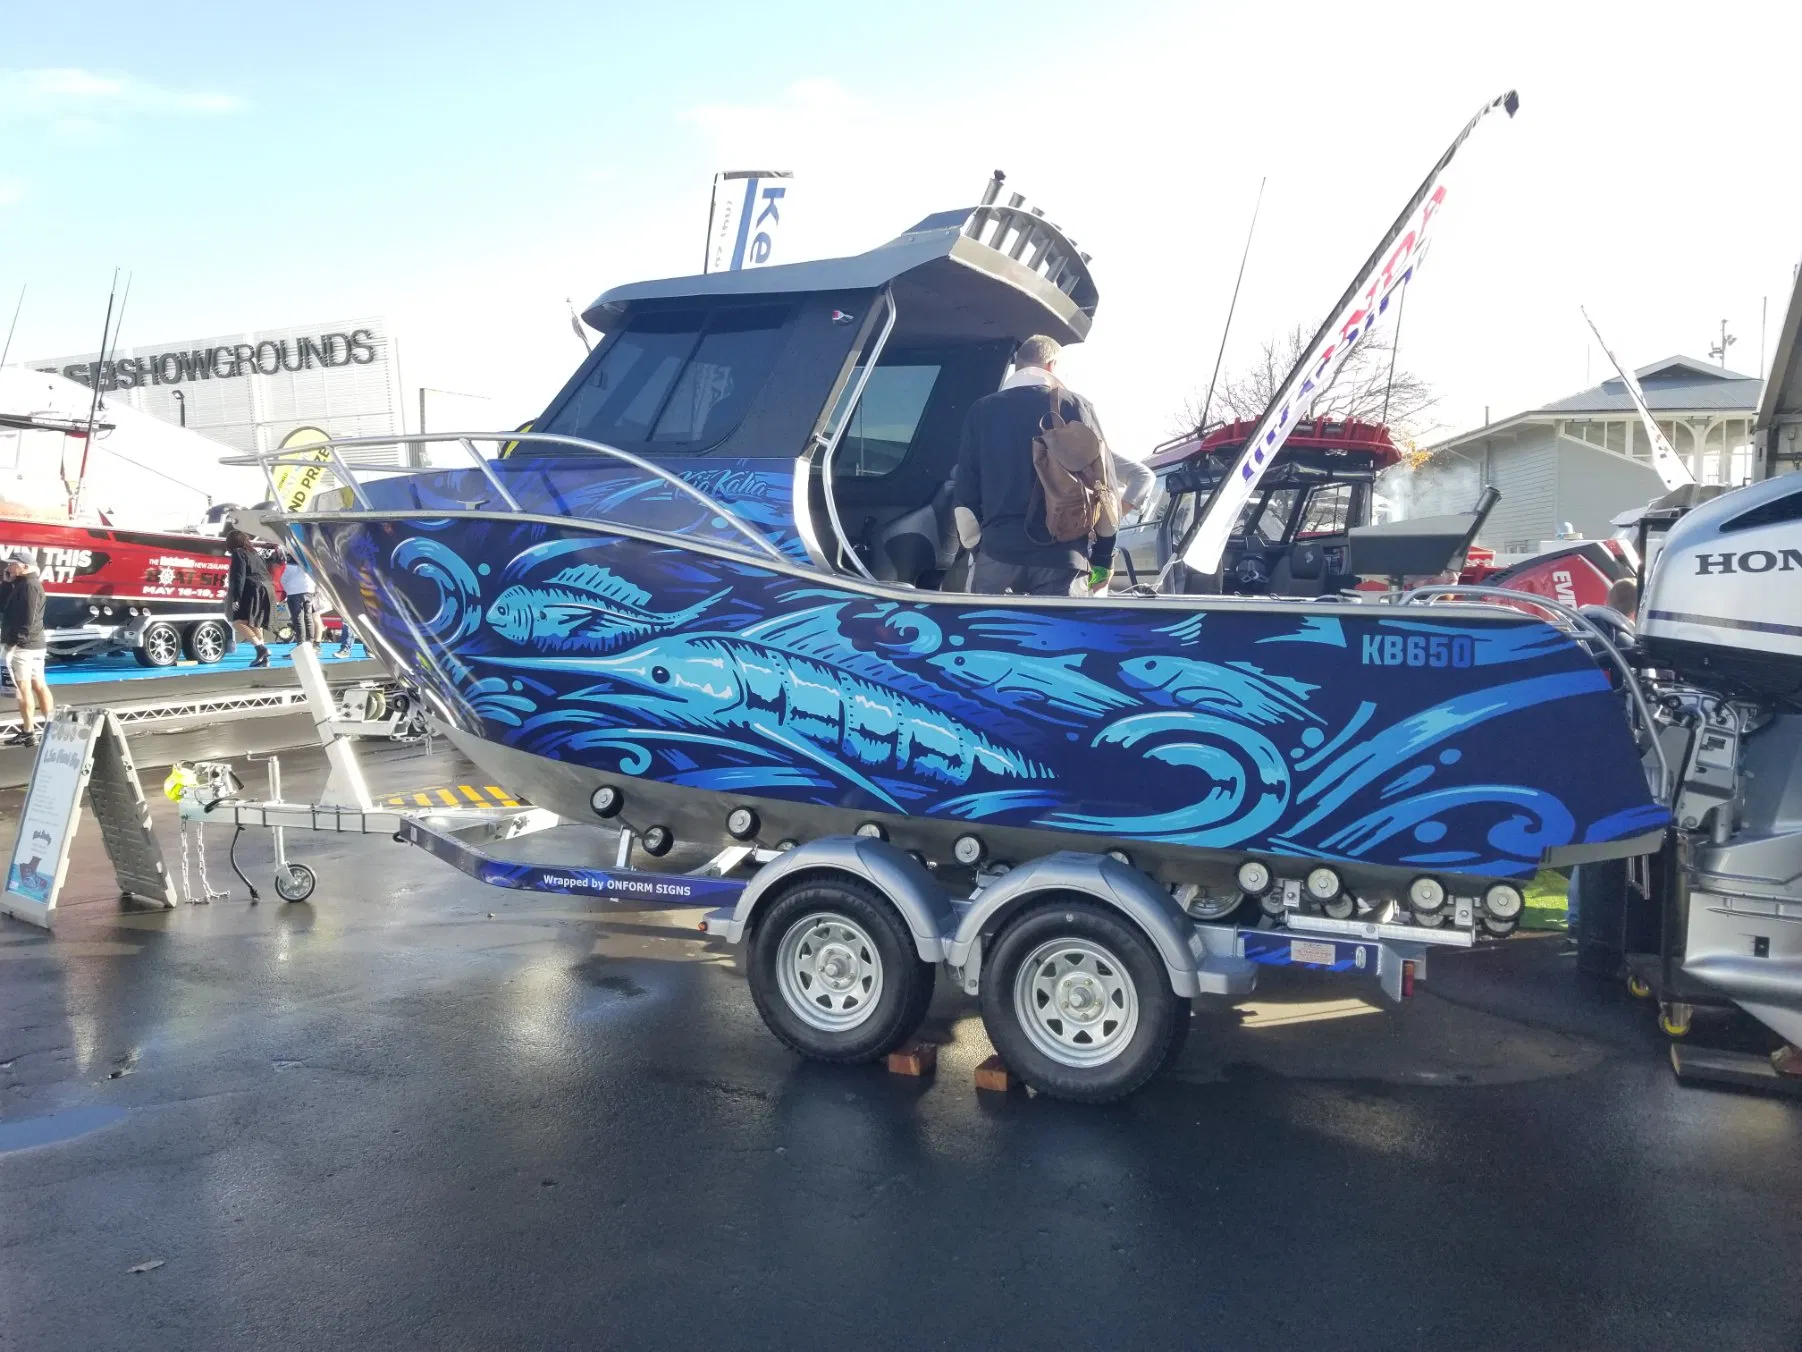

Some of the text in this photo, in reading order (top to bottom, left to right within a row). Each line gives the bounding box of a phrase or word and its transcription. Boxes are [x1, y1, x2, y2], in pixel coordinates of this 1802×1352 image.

[114, 329, 376, 389] SHOWGROUNDS
[42, 547, 92, 568] THIS
[142, 586, 175, 596] MAY
[1362, 634, 1473, 669] KB650
[543, 874, 691, 896] Wrapped by ONFORM SIGNS
